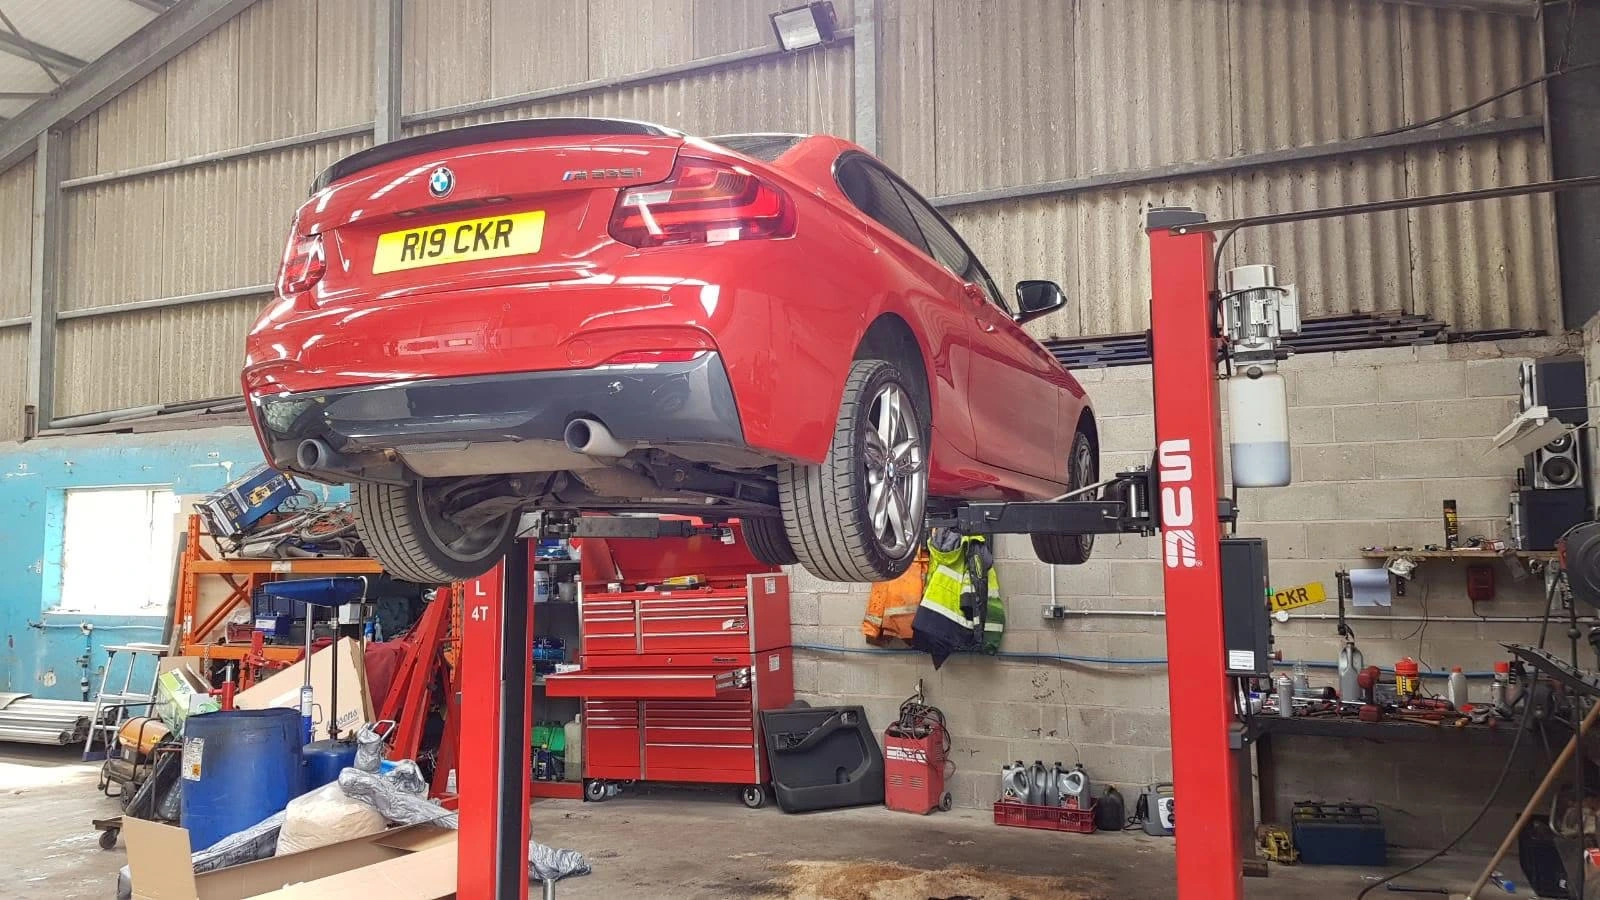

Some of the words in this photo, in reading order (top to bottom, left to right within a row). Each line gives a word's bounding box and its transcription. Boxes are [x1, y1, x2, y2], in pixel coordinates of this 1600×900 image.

[401, 228, 446, 262] R19
[453, 219, 514, 253] CKR
[1275, 587, 1309, 606] CKR
[471, 605, 489, 622] 4T
